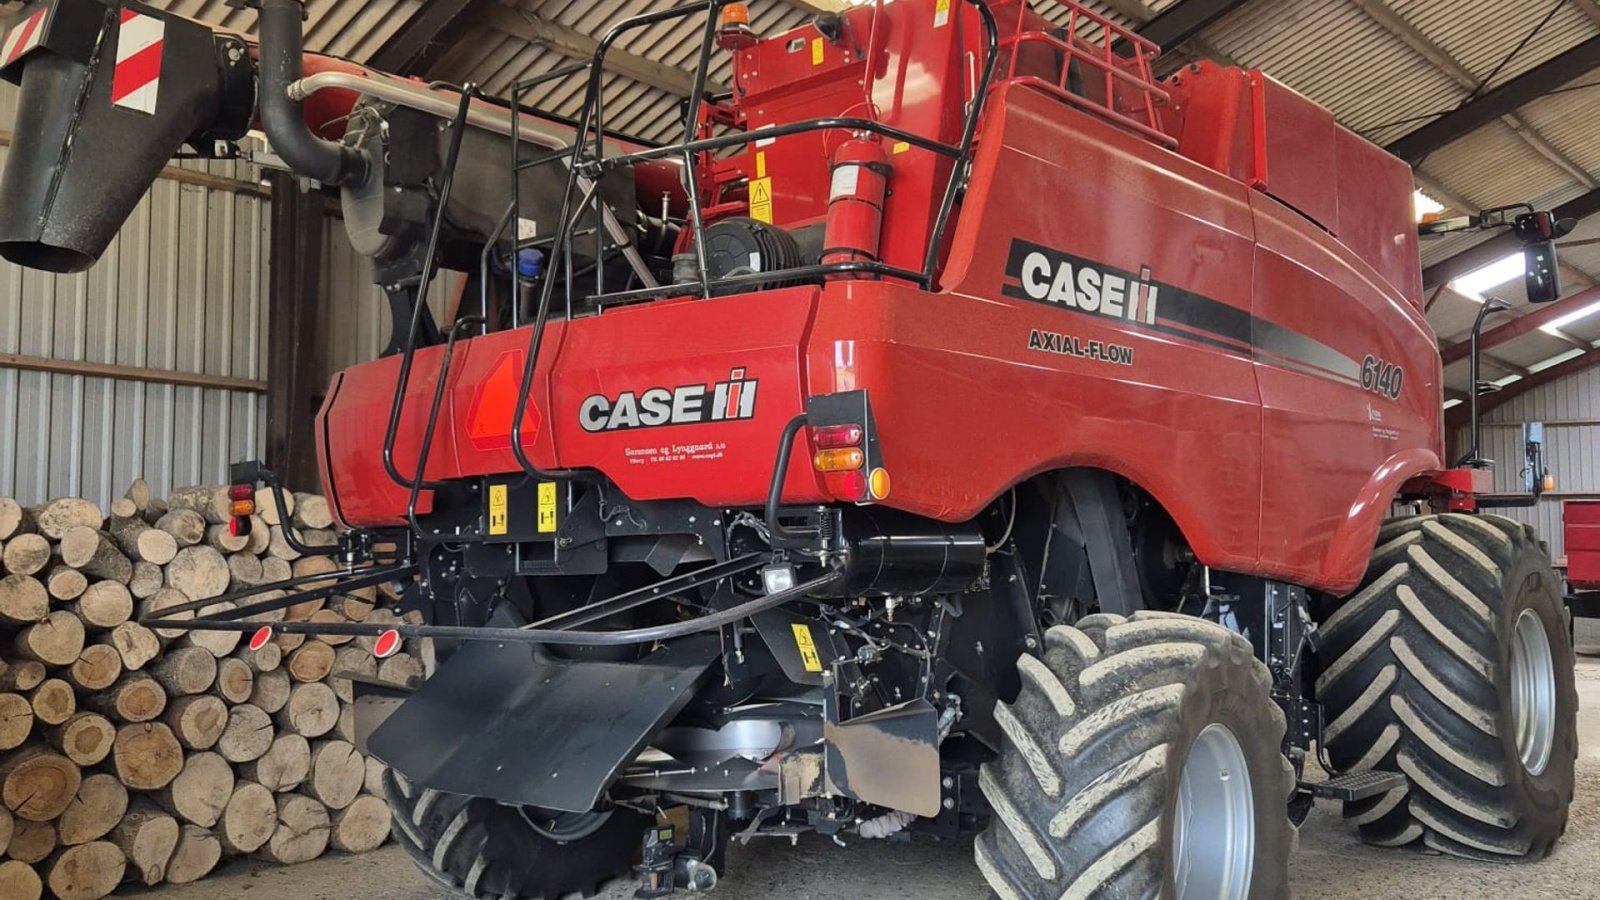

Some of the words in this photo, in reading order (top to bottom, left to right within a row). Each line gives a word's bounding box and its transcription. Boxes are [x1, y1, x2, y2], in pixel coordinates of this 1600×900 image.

[1021, 251, 1126, 318] CASE
[1027, 329, 1134, 366] AXIAL-FLOW
[1361, 354, 1403, 400] 6140
[578, 384, 706, 432] CASE
